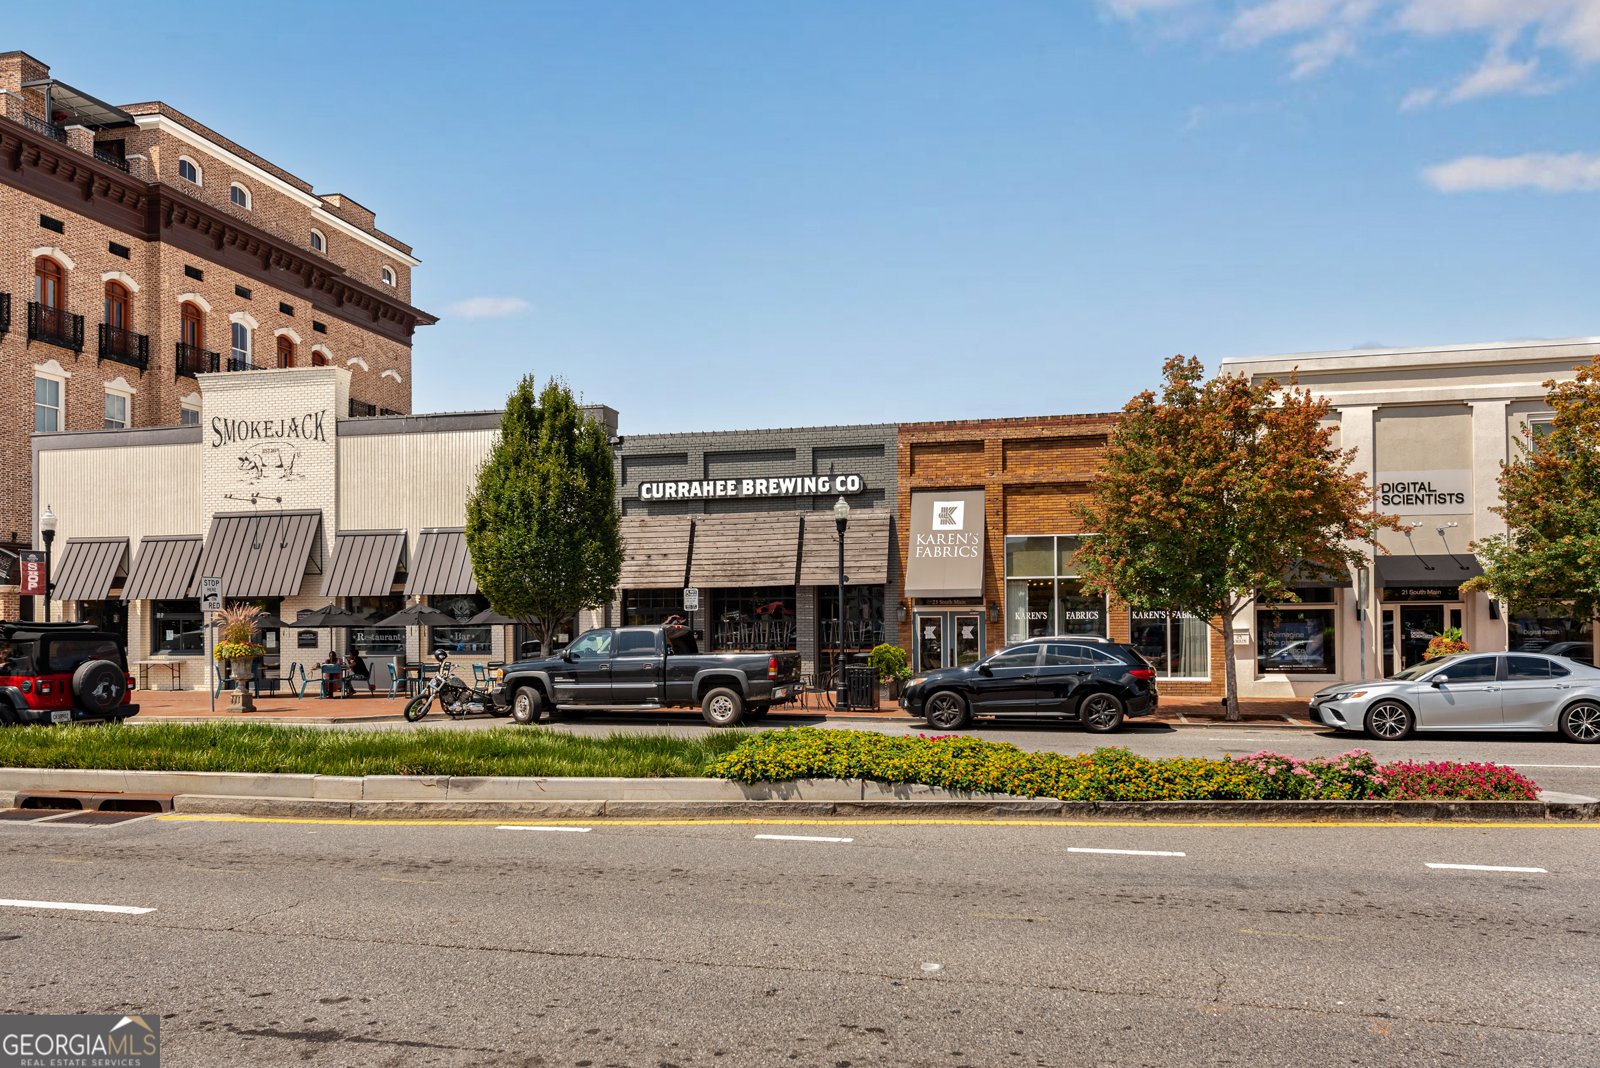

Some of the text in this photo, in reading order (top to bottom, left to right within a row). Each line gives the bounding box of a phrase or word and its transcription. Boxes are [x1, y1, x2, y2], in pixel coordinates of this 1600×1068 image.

[641, 475, 860, 499] CURRAHEE BREWING CO
[1381, 481, 1437, 494] DIGITAL
[1381, 493, 1465, 506] SCIENTISTS
[916, 533, 979, 545] KAREN'S
[915, 546, 979, 558] FABRICS
[27, 562, 39, 591] SHOP
[1015, 611, 1099, 620] KAREN'S FABRICS
[1132, 610, 1166, 619] KAREN'S
[357, 632, 401, 641] Restaurant
[455, 632, 470, 640] Bar
[1268, 631, 1305, 639] Reimagine
